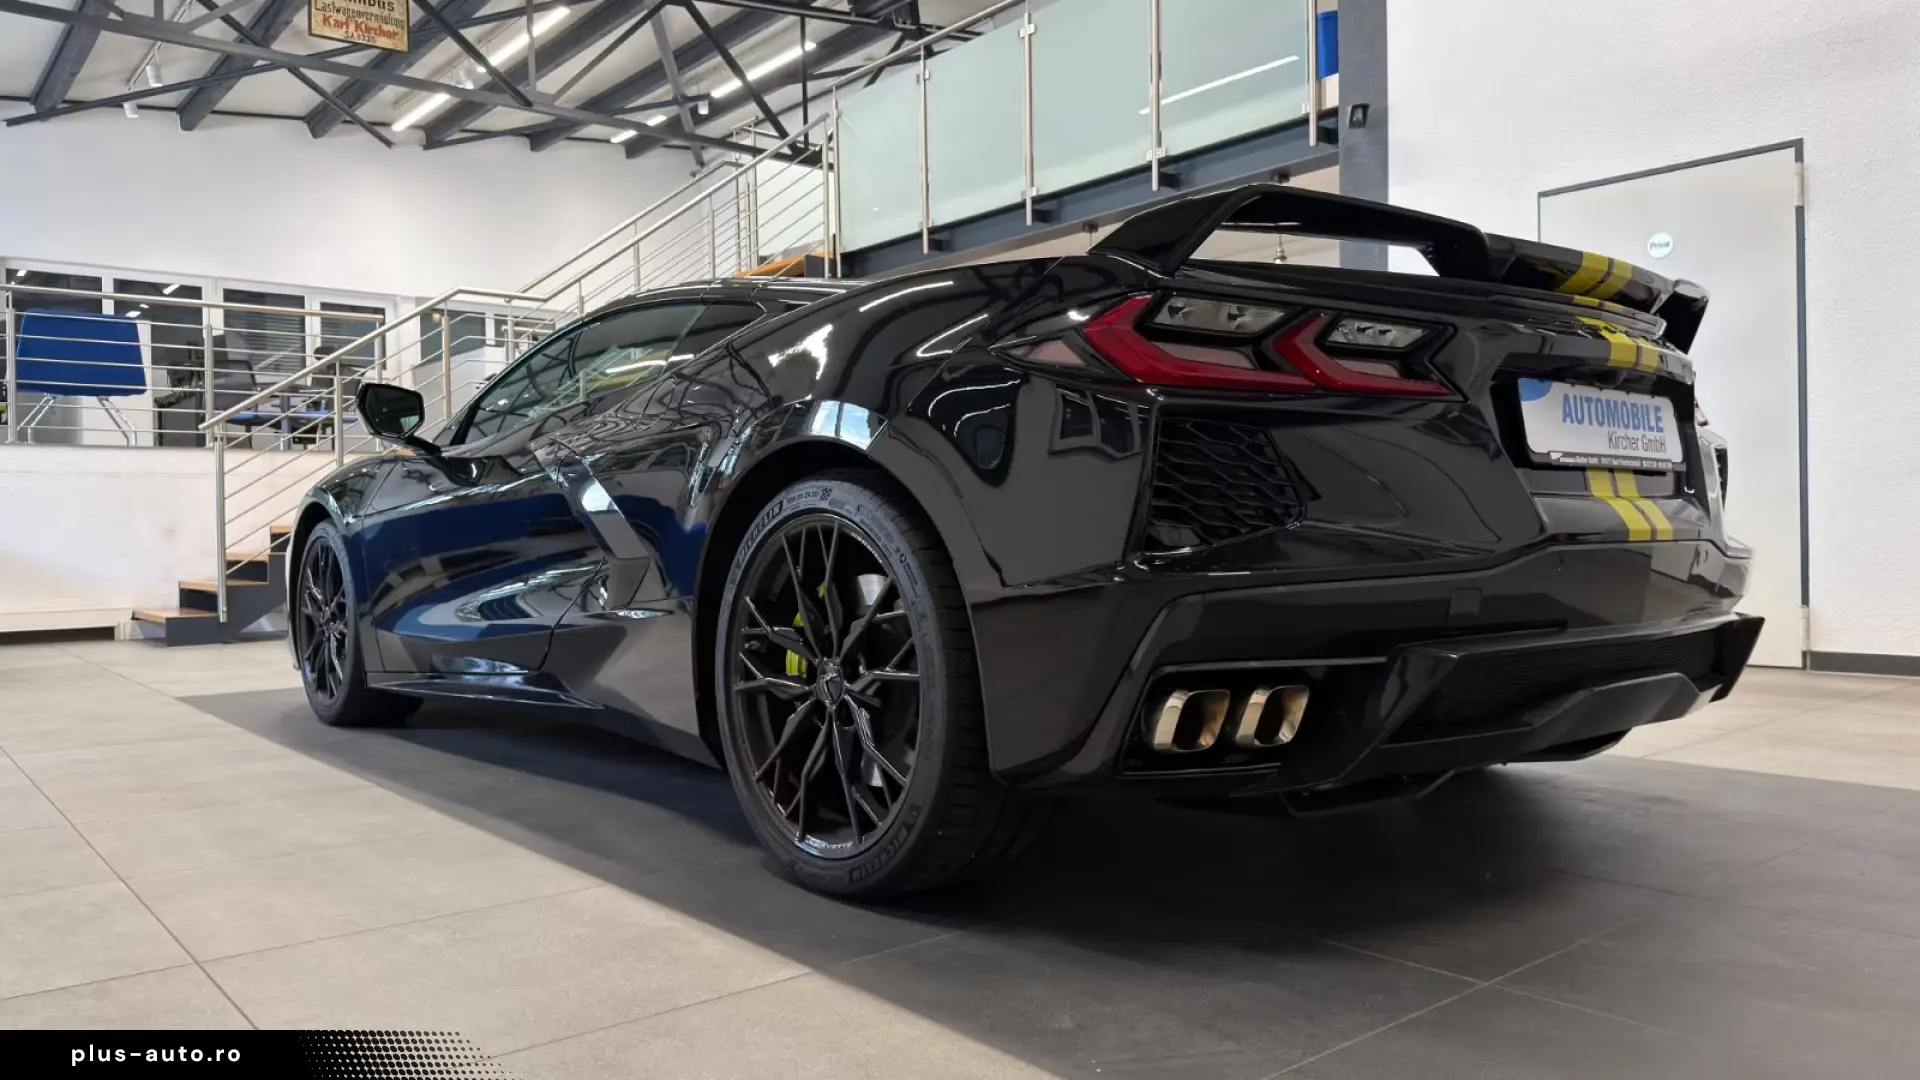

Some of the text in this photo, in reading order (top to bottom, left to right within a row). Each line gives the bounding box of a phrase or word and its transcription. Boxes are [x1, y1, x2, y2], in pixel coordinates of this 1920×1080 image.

[322, 13, 350, 30] Karl
[1562, 394, 1664, 433] AUTOMOBILE
[1607, 431, 1667, 453] Kircher GmbH
